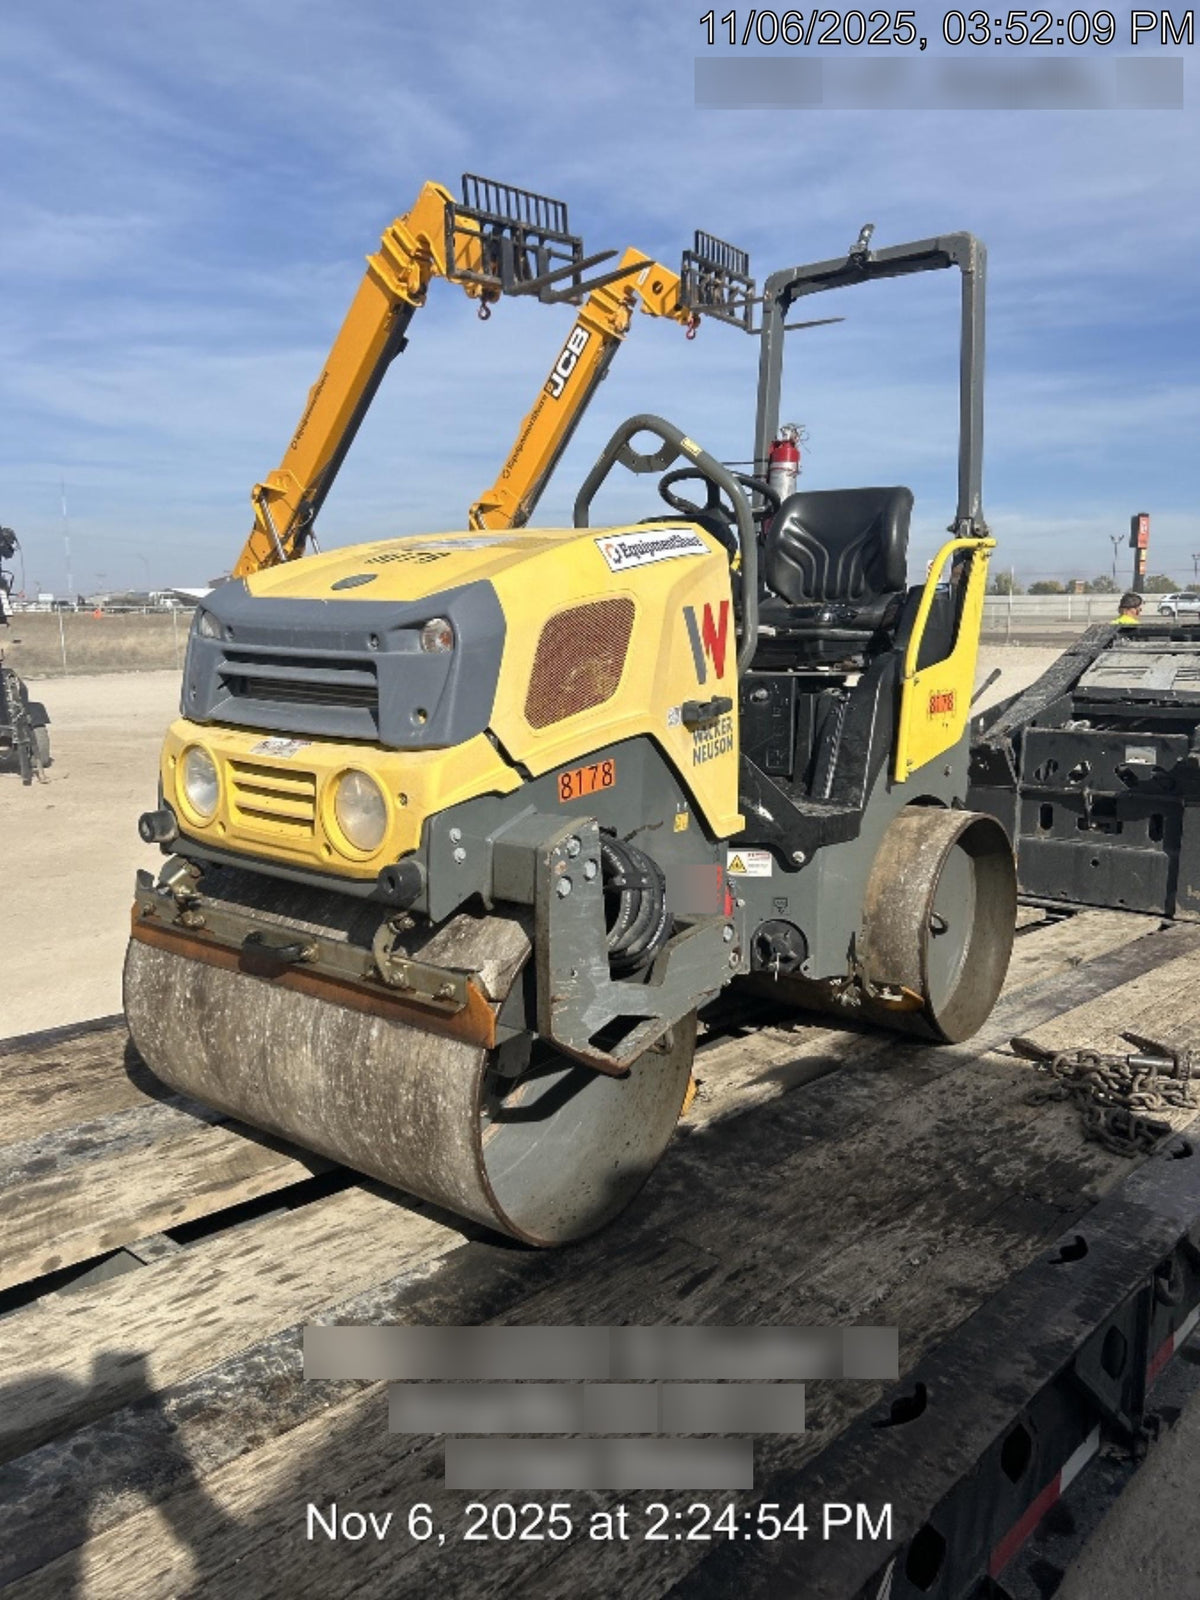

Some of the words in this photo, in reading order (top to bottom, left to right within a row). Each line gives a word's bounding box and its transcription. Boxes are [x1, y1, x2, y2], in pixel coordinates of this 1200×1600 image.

[551, 326, 589, 398] JCB
[692, 733, 733, 767] NEUSON
[560, 761, 613, 800] 8178
